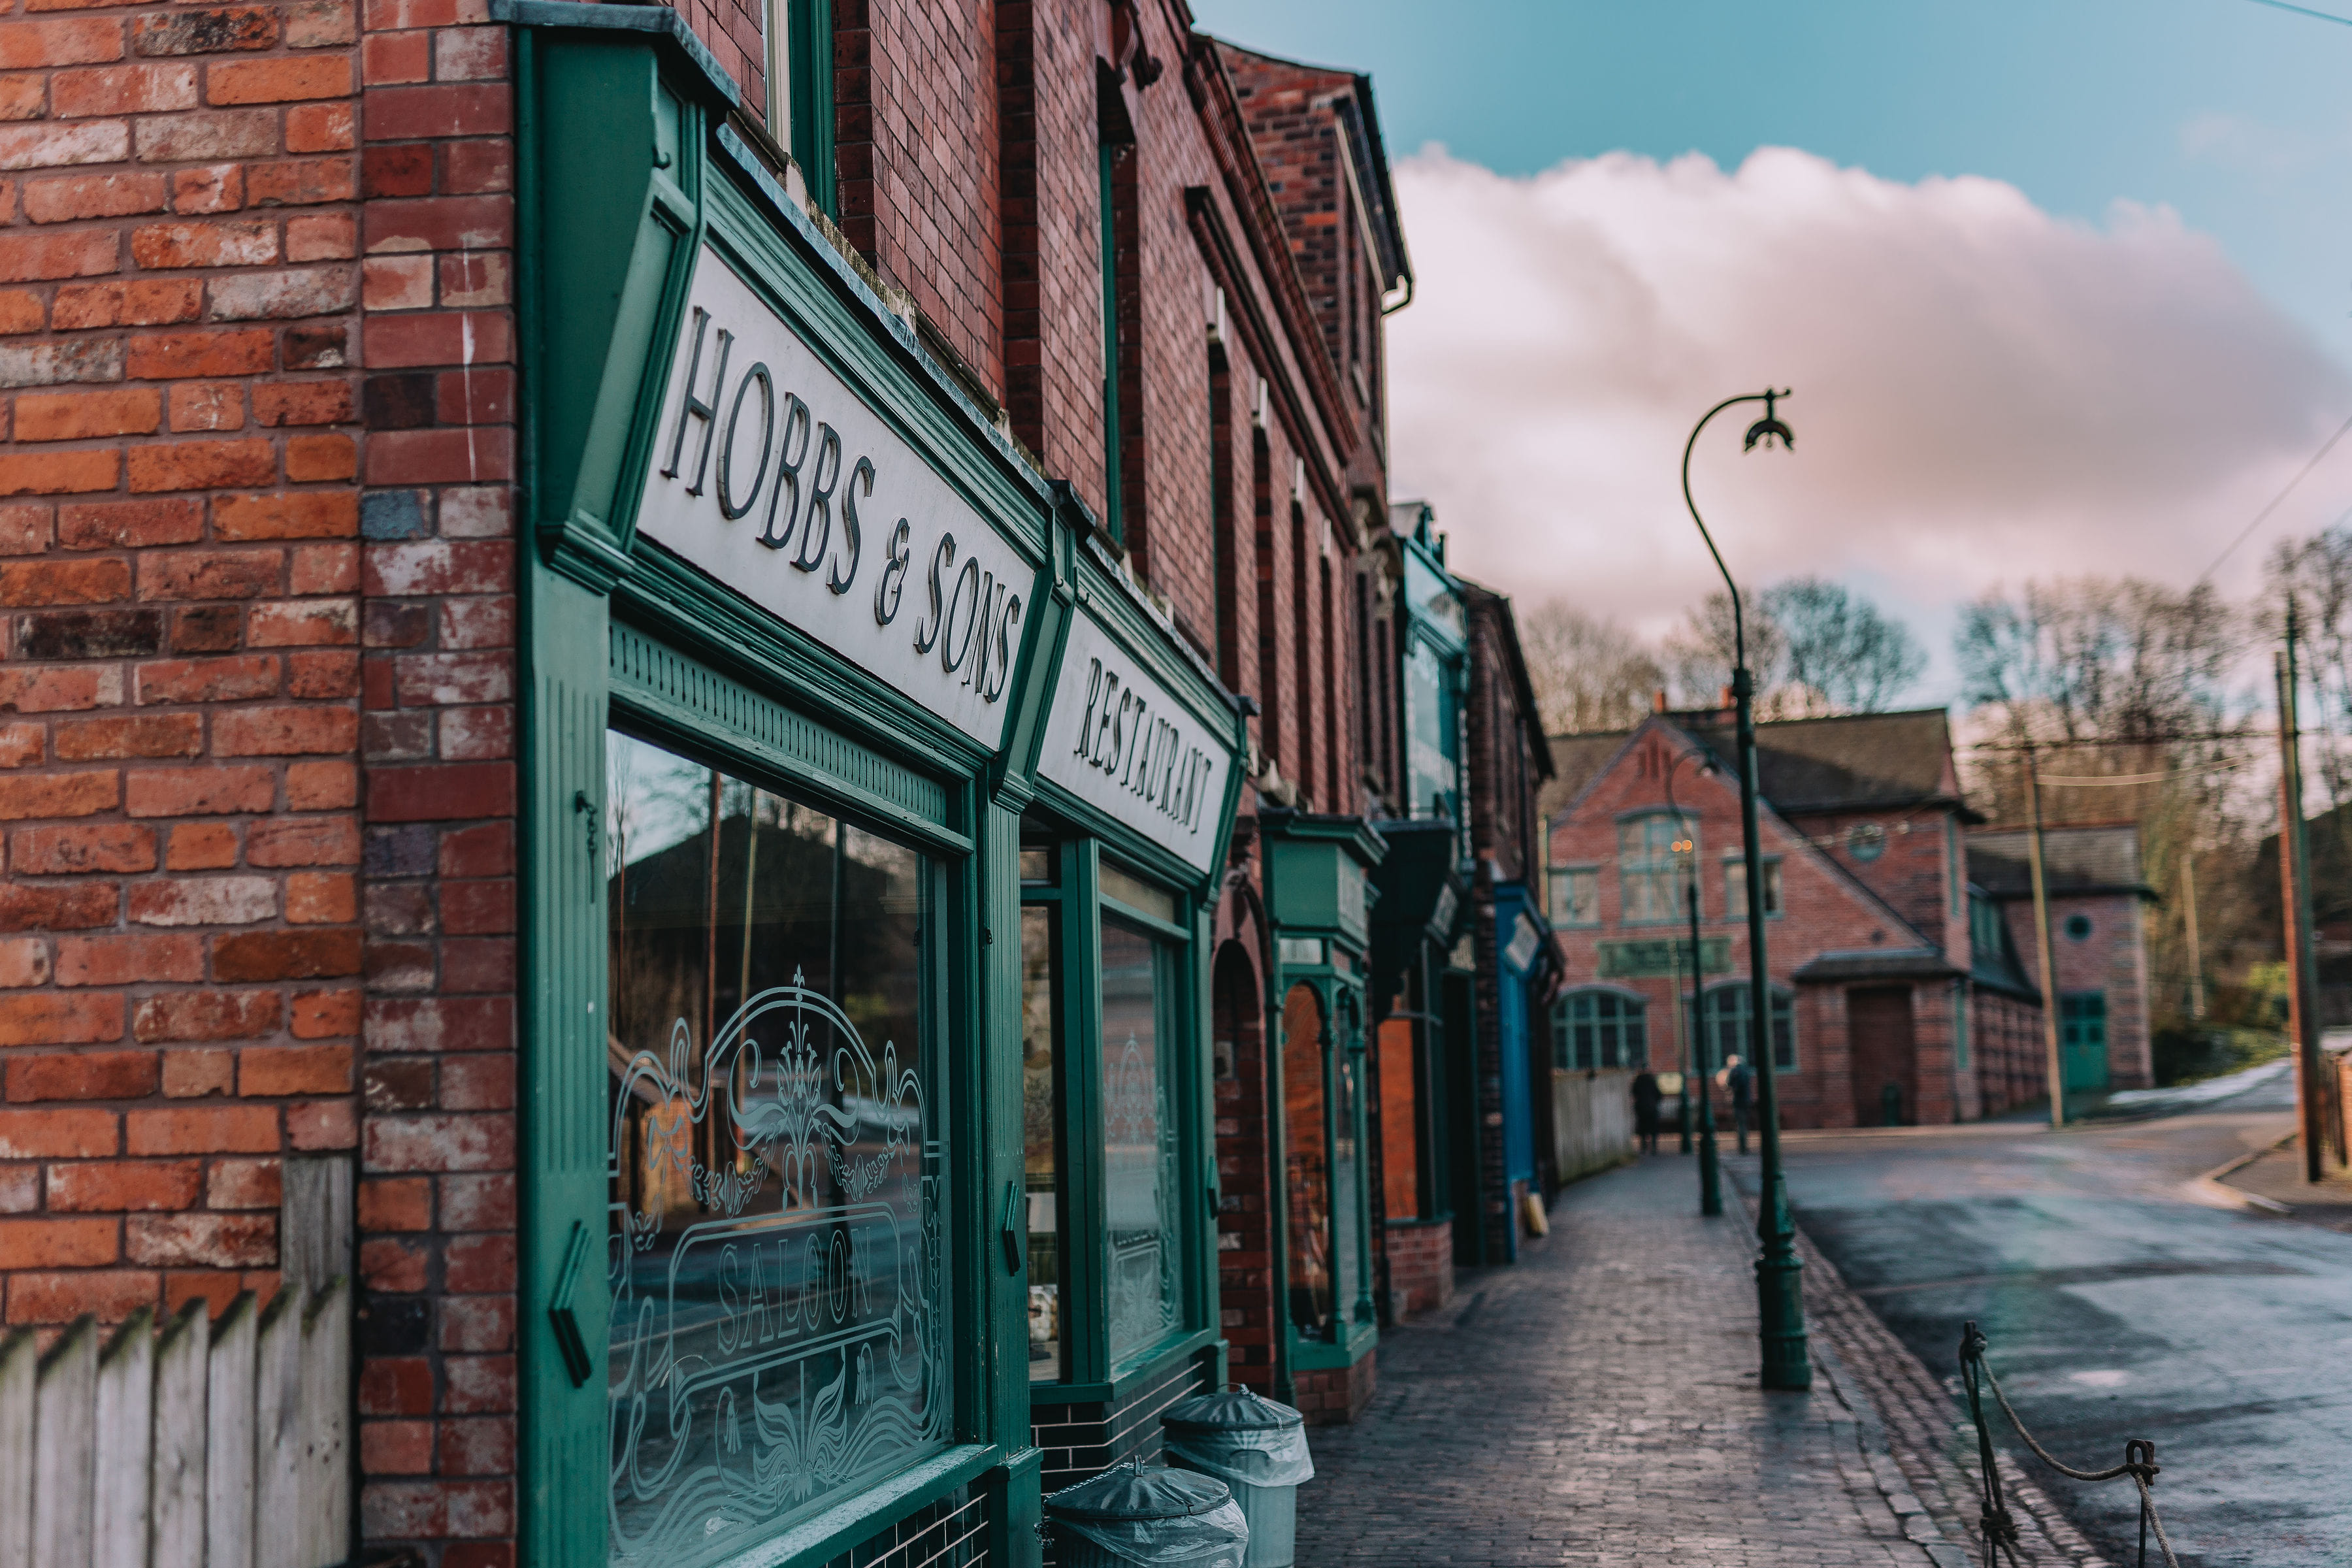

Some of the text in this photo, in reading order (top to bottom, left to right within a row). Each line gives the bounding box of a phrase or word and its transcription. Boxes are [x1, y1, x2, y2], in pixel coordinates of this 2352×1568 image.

[659, 305, 1021, 703] HOBBS & SONS
[1073, 657, 1212, 835] RESTAURANT
[718, 1226, 873, 1356] SALOON
